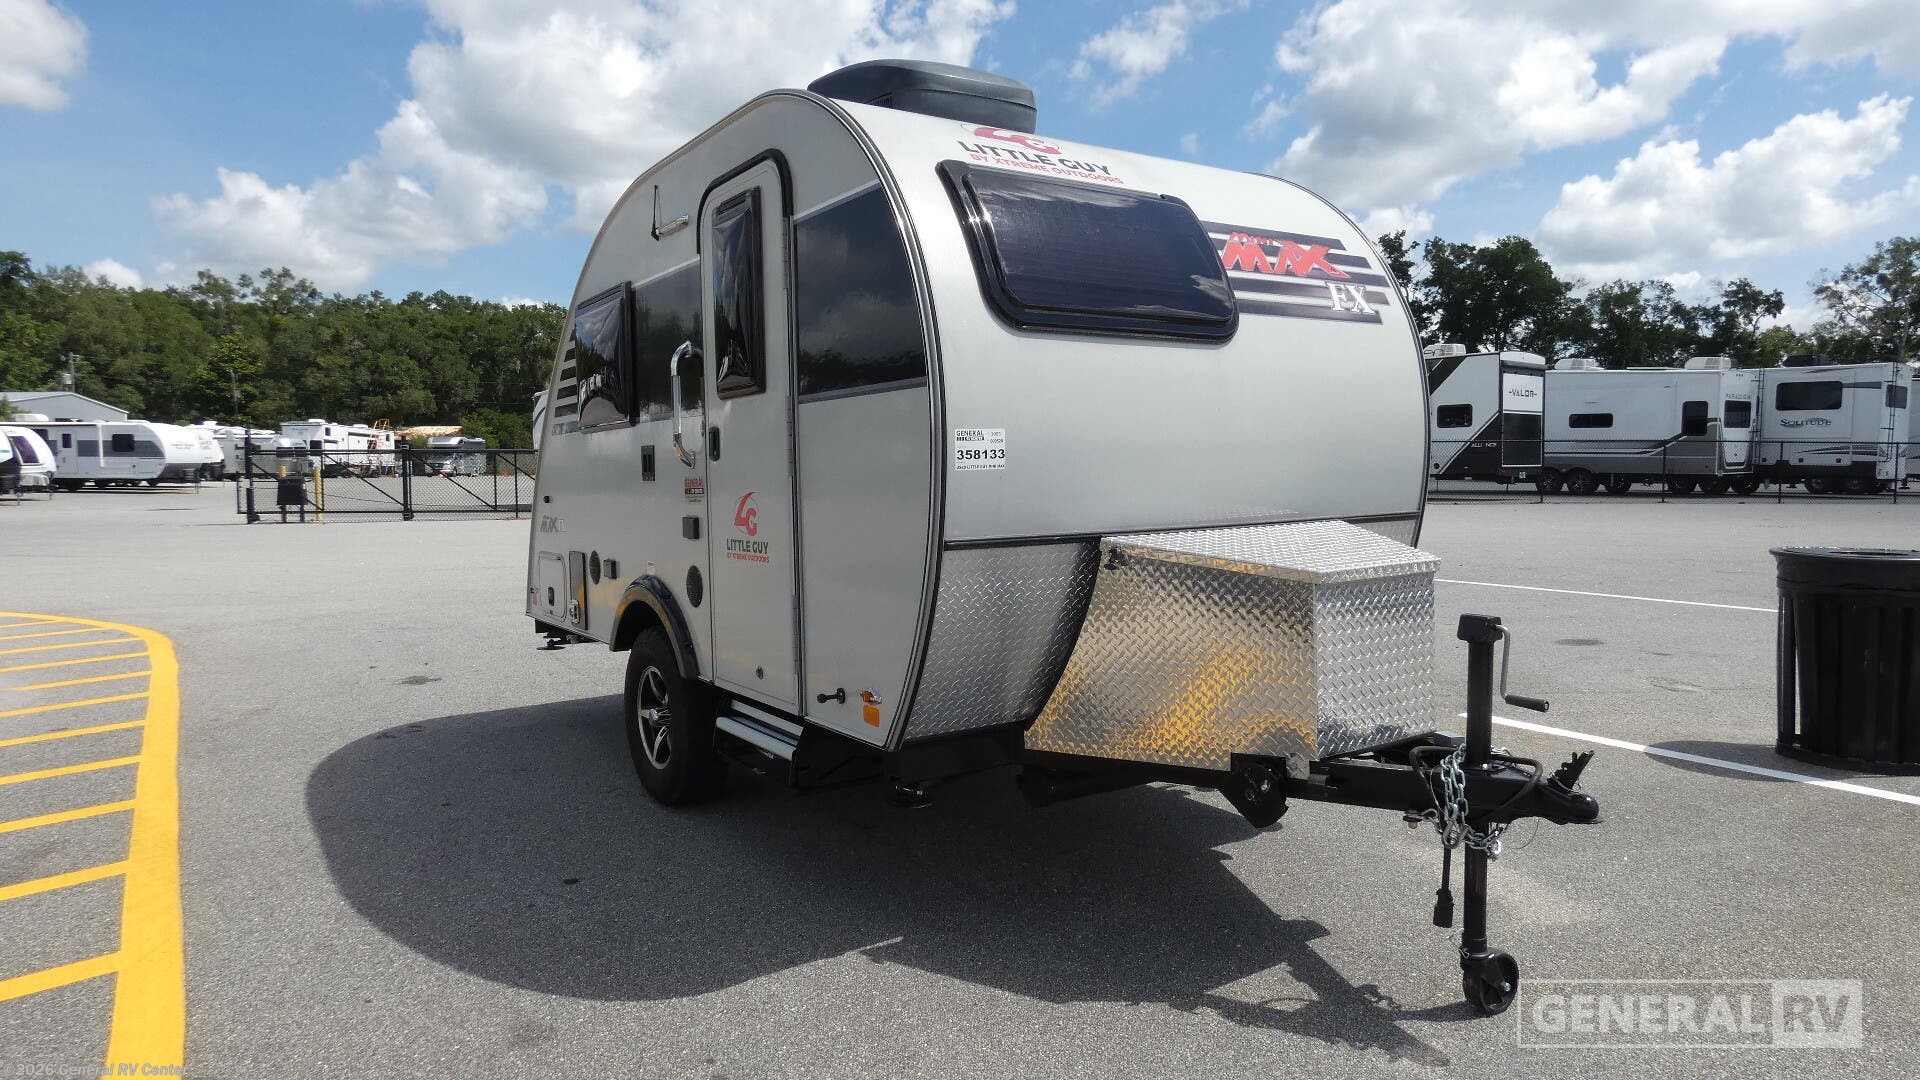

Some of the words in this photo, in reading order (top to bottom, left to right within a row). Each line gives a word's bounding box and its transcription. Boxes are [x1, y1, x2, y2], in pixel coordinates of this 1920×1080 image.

[957, 141, 1056, 167] LITTLE
[1058, 158, 1112, 176] GUY
[970, 153, 989, 163] BY
[992, 157, 1051, 173] XTREME
[1051, 167, 1124, 185] OUTDOORS
[956, 449, 1006, 460] 358133
[726, 538, 751, 553] LITTLE
[752, 541, 769, 555] GUY
